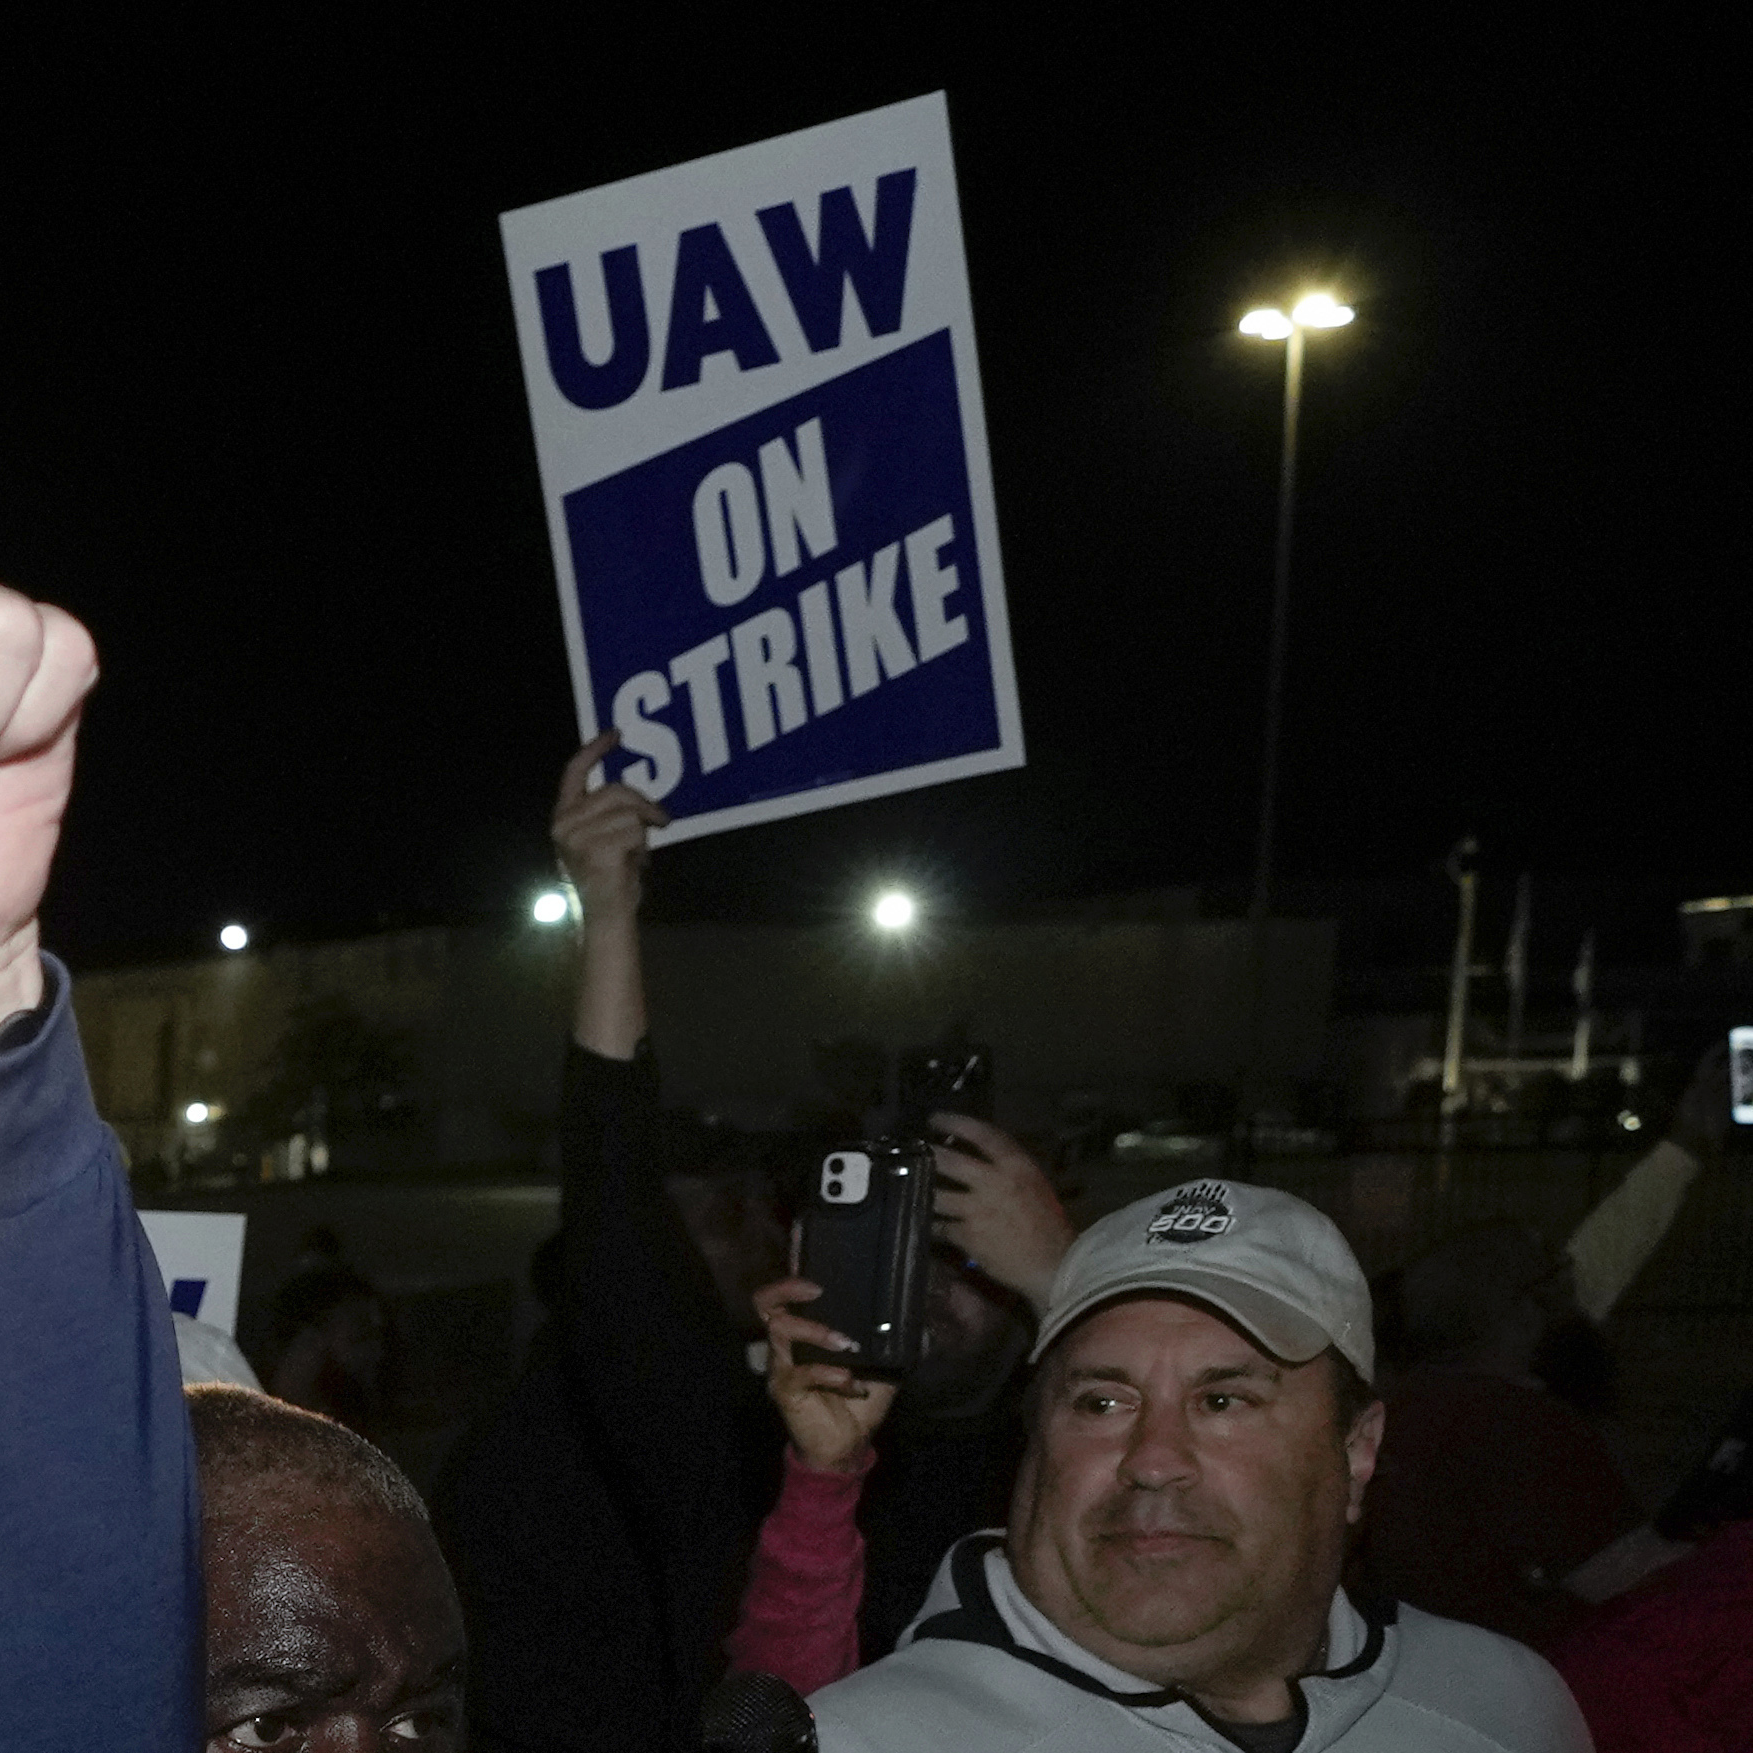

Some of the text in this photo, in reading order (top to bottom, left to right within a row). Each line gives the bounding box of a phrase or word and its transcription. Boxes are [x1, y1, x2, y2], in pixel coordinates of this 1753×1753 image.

[534, 167, 917, 412] UAW
[694, 416, 837, 608] ON
[611, 513, 969, 802] STRIKE
[1148, 1214, 1231, 1233] 500
